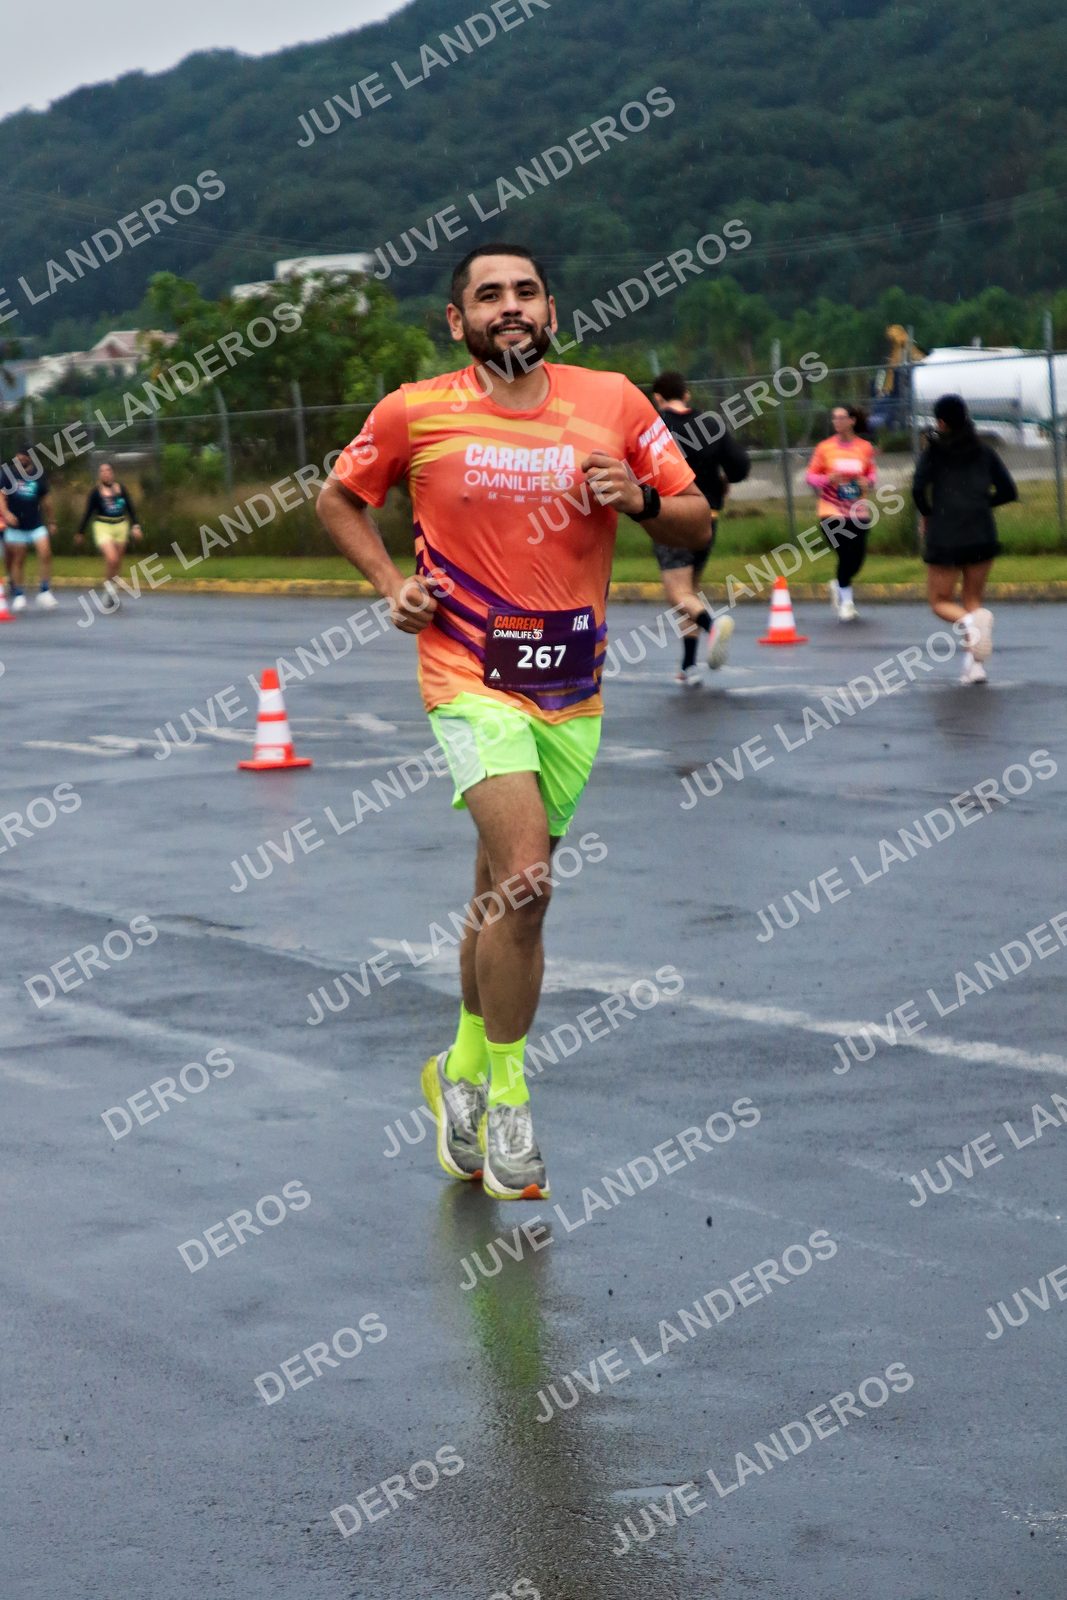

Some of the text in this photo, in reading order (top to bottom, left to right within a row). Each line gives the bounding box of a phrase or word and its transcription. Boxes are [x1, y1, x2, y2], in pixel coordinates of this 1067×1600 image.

[465, 443, 576, 472] CARRERA
[494, 614, 590, 631] CARRERA 15K
[517, 645, 567, 668] 267
